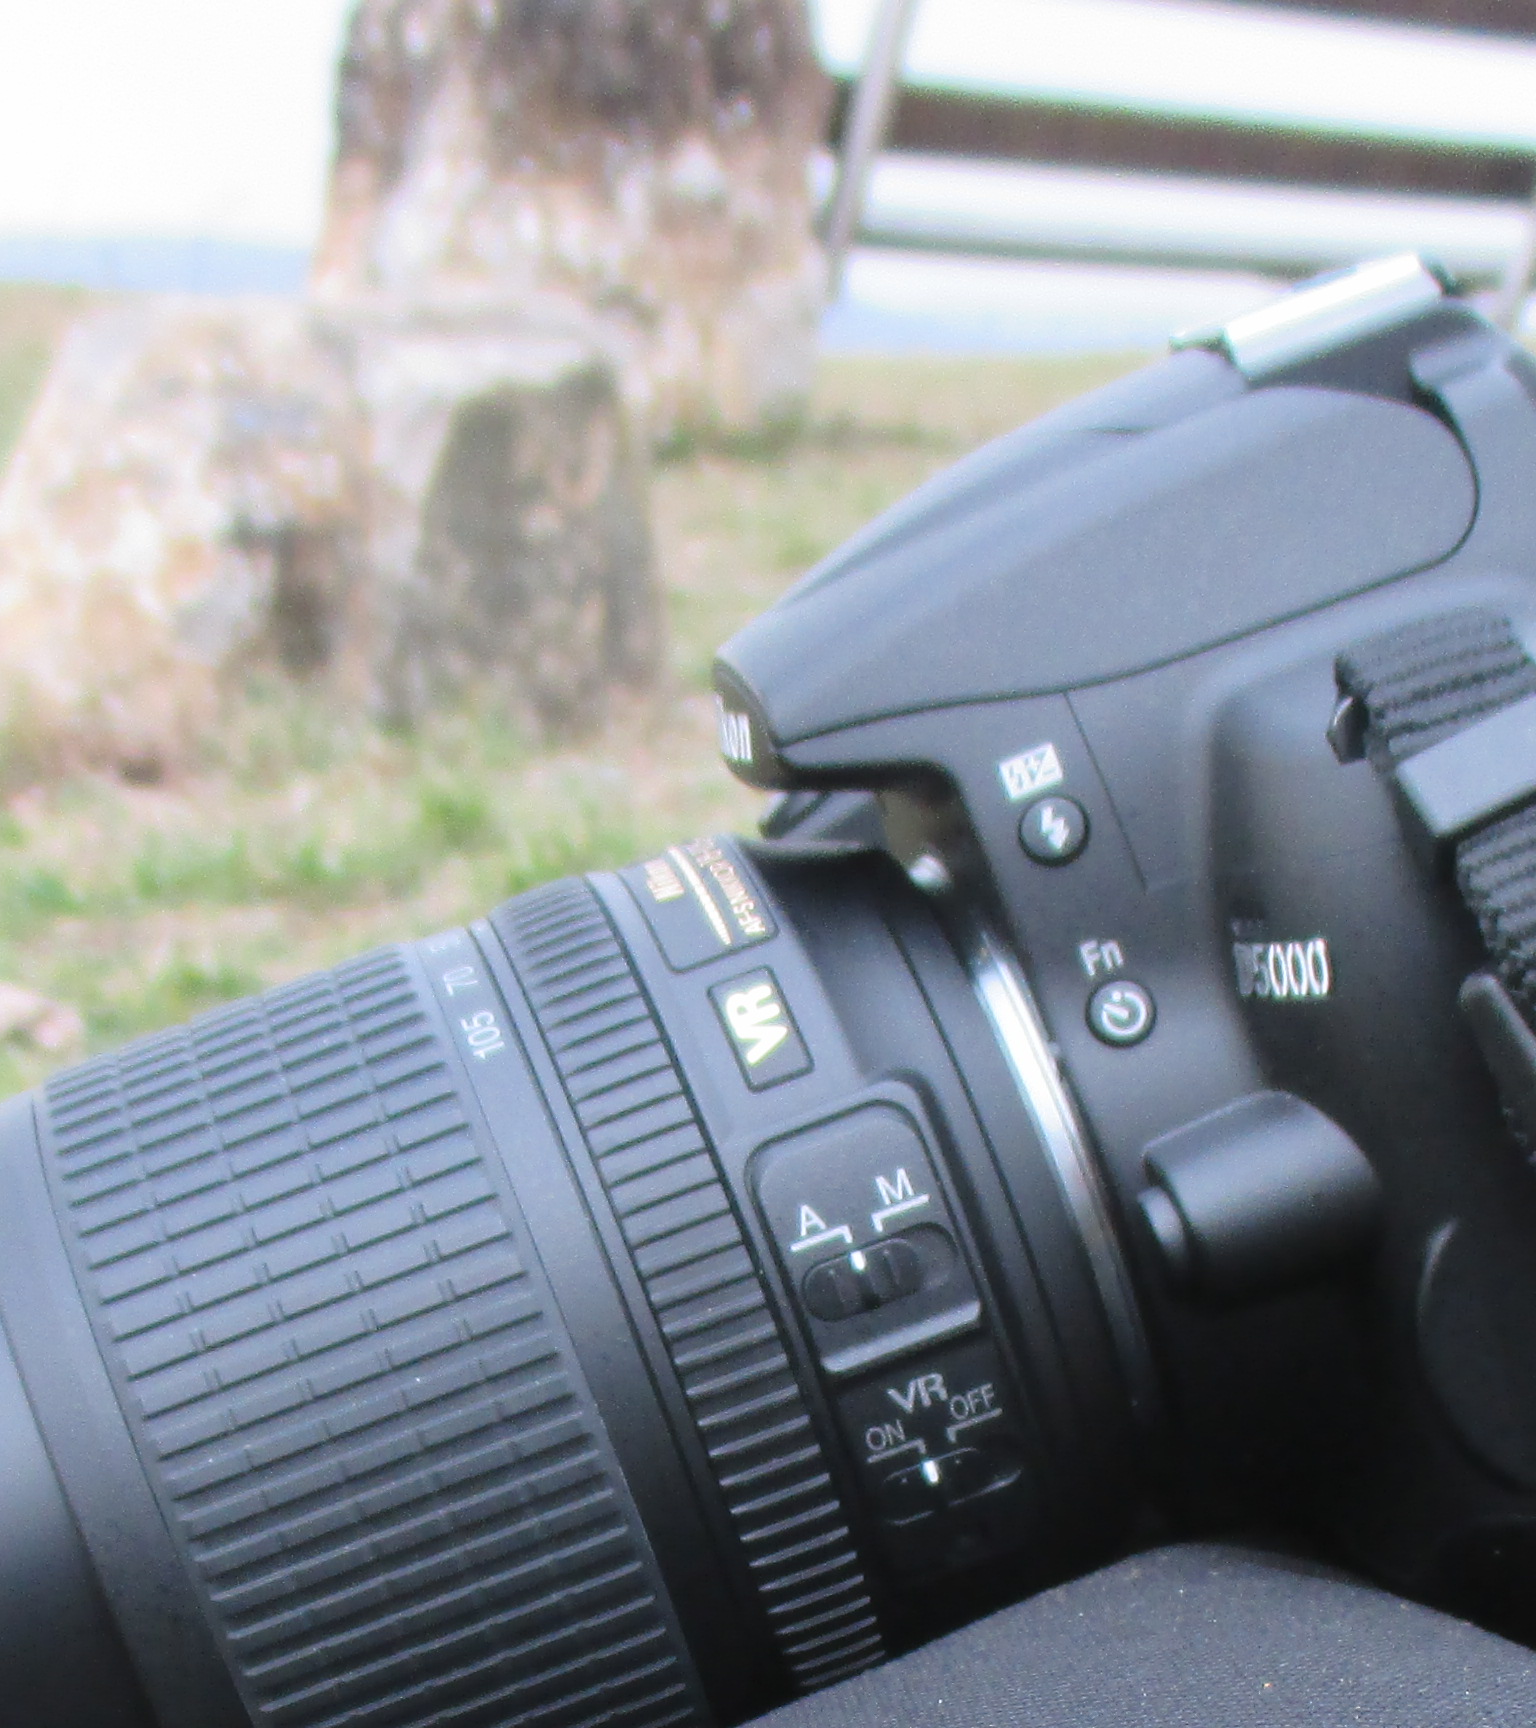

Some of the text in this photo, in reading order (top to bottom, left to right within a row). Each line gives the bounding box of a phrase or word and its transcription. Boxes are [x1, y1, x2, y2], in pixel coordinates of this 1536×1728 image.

[1078, 938, 1124, 976] Fn
[460, 1010, 505, 1060] 105
[725, 981, 788, 1066] VR
[875, 1168, 914, 1205] M
[799, 1204, 826, 1236] A
[887, 1373, 948, 1414] VR
[950, 1382, 997, 1421] OFF
[866, 1420, 905, 1452] ON
